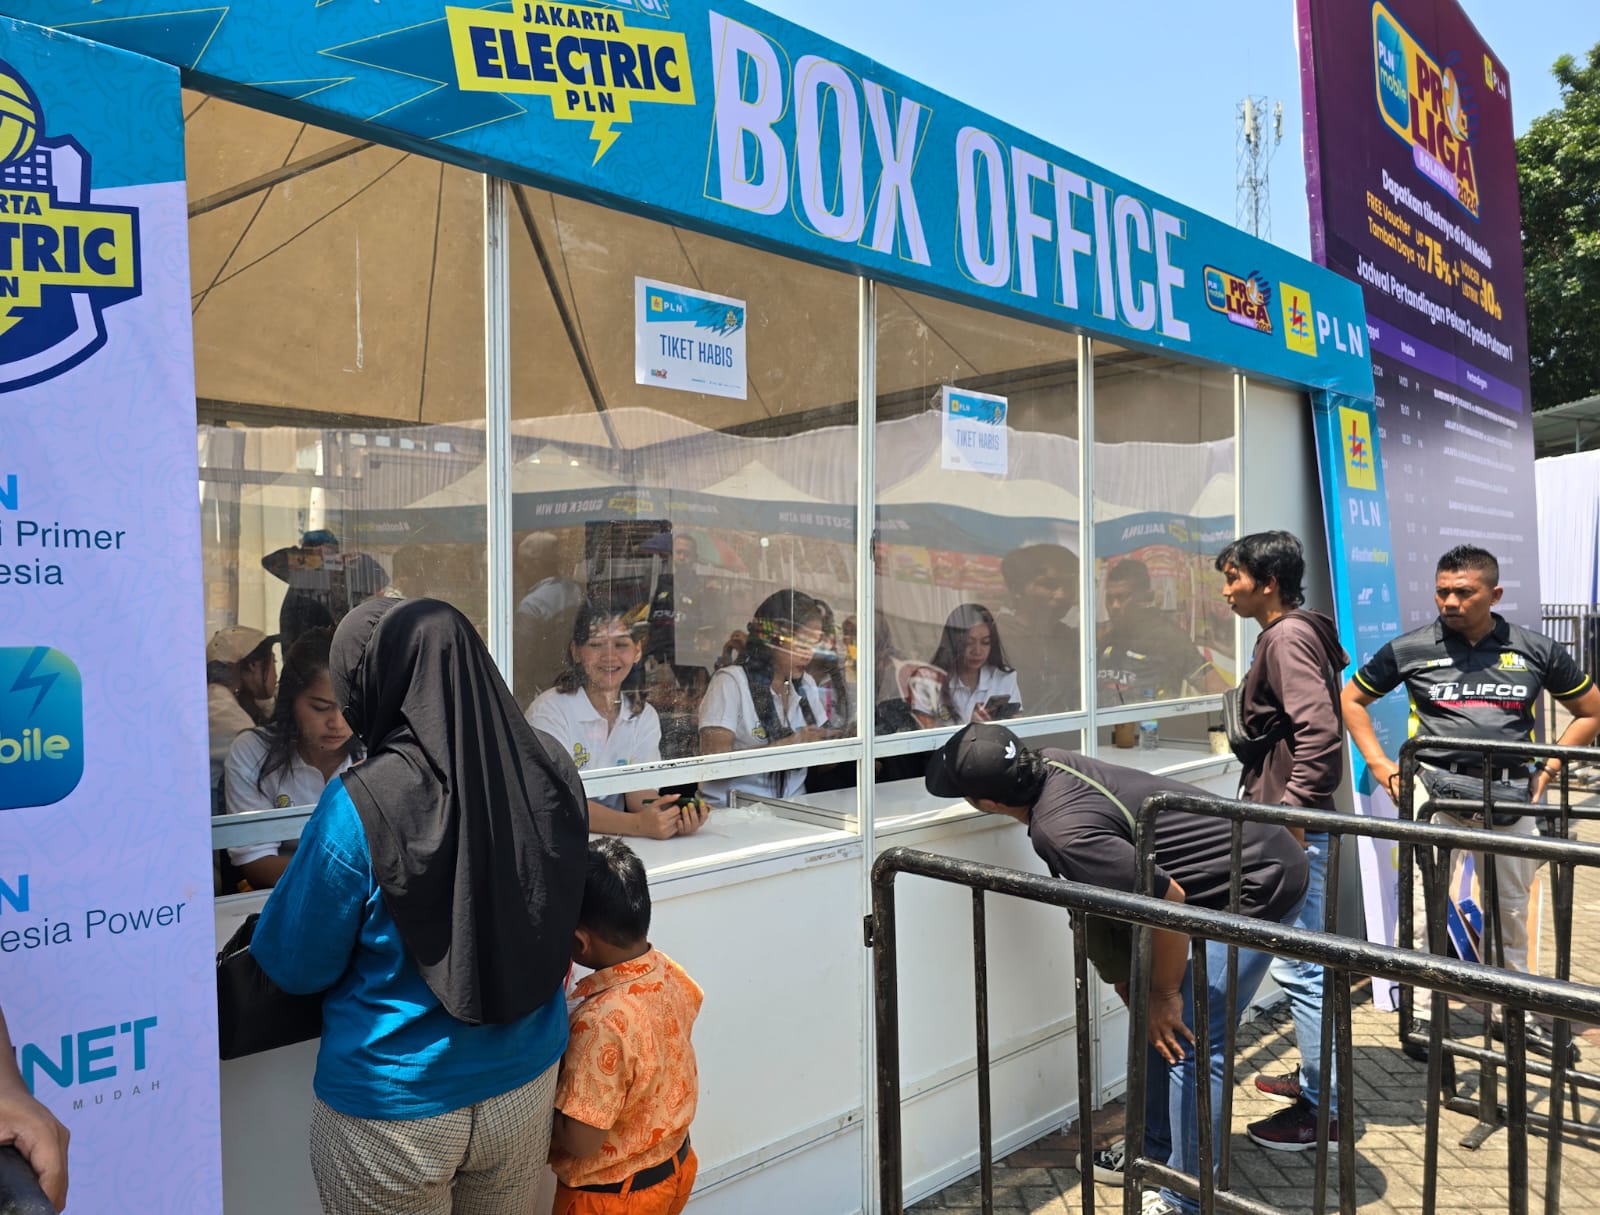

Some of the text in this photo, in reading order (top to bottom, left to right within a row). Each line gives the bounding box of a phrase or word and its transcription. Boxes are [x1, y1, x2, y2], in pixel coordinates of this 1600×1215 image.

[523, 3, 620, 33] JAKARTA
[469, 25, 681, 93] ELECTRIC
[1378, 39, 1395, 70] PLN
[566, 89, 615, 113] PLN
[1493, 71, 1506, 100] PLN
[1409, 92, 1475, 193] LIGA
[705, 9, 1190, 342] BOX OFFICE
[1366, 189, 1411, 237] FREE Voucher
[1382, 168, 1423, 217] Dapatkan
[1423, 200, 1454, 241] tiketnya
[1367, 215, 1415, 264] Tambah Daya
[1416, 228, 1424, 247] UP
[1416, 252, 1426, 271] TO
[663, 301, 683, 313] PLN
[1226, 294, 1269, 324] LIGA
[1357, 254, 1390, 294] Jadwal
[1390, 275, 1446, 326] Pertandingan
[1445, 306, 1467, 337] Pekan
[1466, 318, 1471, 338] 2
[1471, 325, 1487, 347] pada
[1487, 332, 1509, 361] Putaran
[1316, 311, 1364, 358] PLN
[659, 334, 733, 368] TIKET HABIS
[956, 429, 1000, 450] TIKET HABIS
[1348, 497, 1381, 527] PLN
[16, 519, 126, 550] Primer
[0, 557, 64, 585] esia
[1462, 683, 1528, 697] LIFCO
[0, 902, 187, 953] esia Power
[12, 1016, 158, 1096] NET
[73, 1080, 160, 1110] MUDAH
